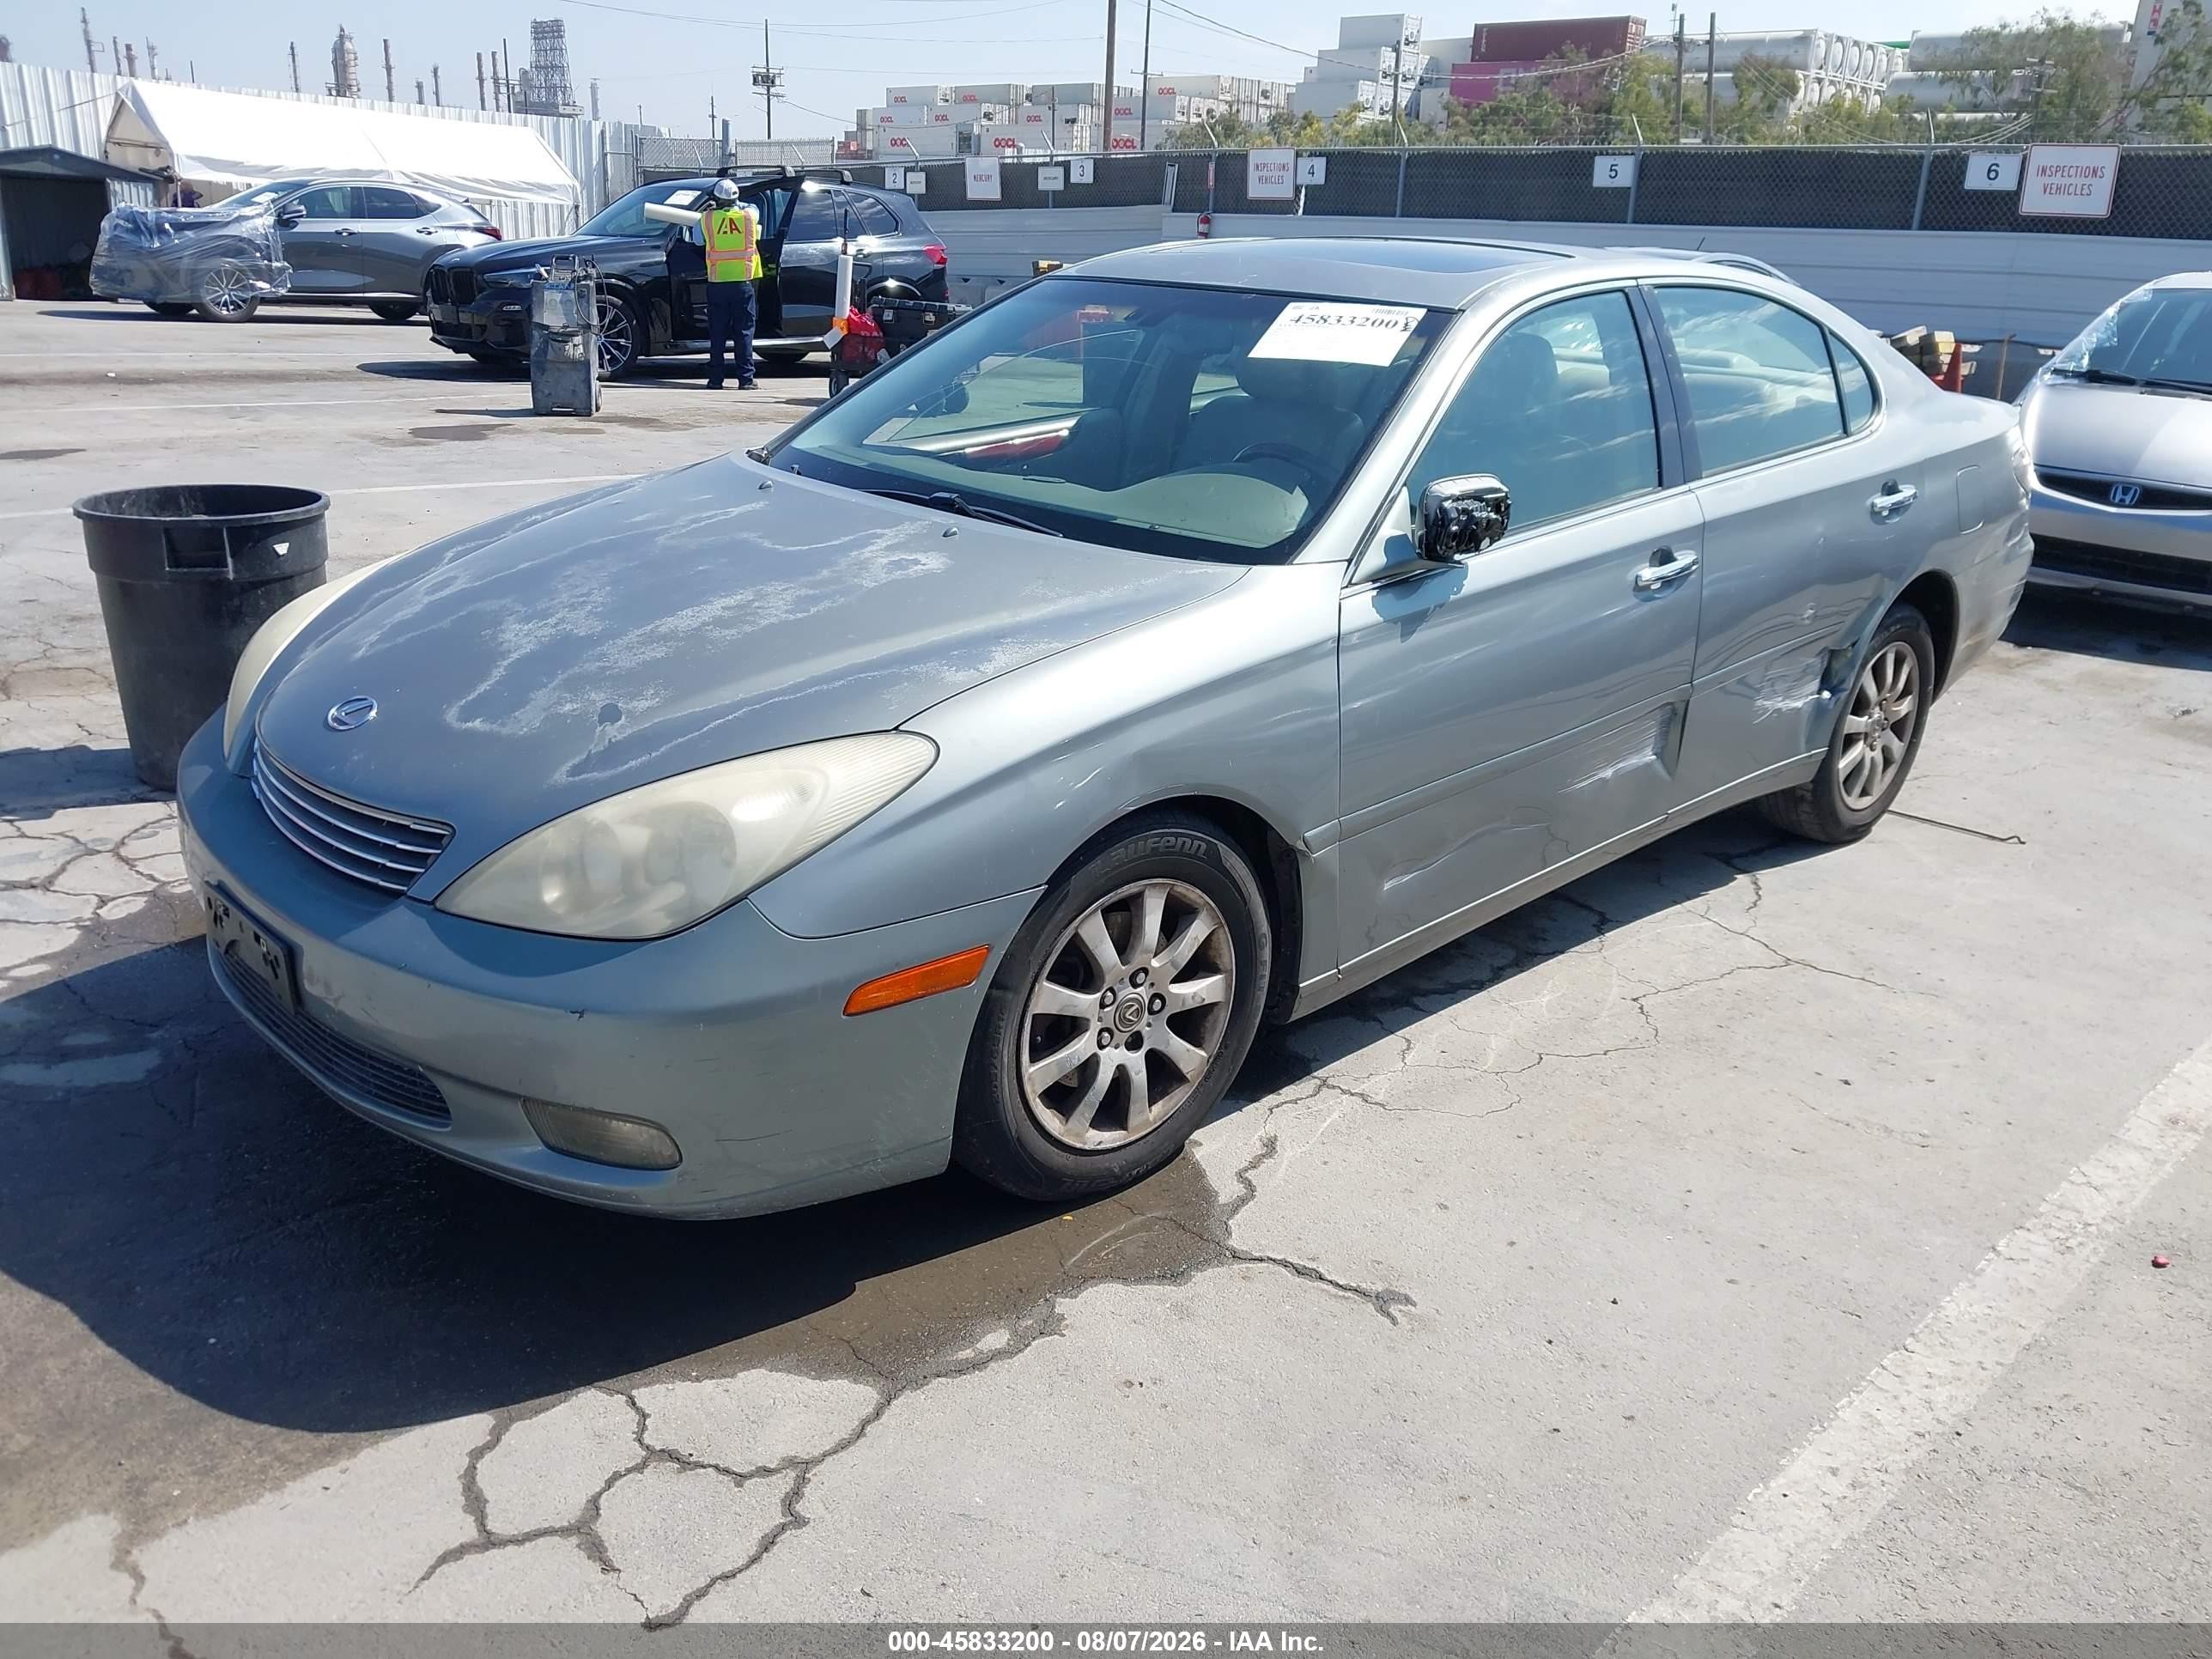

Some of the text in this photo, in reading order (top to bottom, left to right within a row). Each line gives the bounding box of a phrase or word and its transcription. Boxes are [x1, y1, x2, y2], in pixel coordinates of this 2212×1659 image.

[934, 113, 950, 122] OOCL
[1114, 107, 1133, 116] OOCL
[994, 137, 1018, 149] OOCL
[1111, 138, 1137, 149] OOCL
[1079, 164, 1085, 178] 3
[1253, 162, 1290, 173] INSPECTIONS
[1307, 164, 1316, 178] 4
[1608, 163, 1620, 179] 5
[1986, 163, 2000, 180] 6
[2036, 165, 2106, 179] INSPECTIONS
[892, 173, 897, 184] 2
[973, 173, 994, 183] MERCURY
[1257, 175, 1285, 185] VEHICLES
[2042, 182, 2094, 197] VEHICLES
[1290, 314, 1399, 330] 45833200
